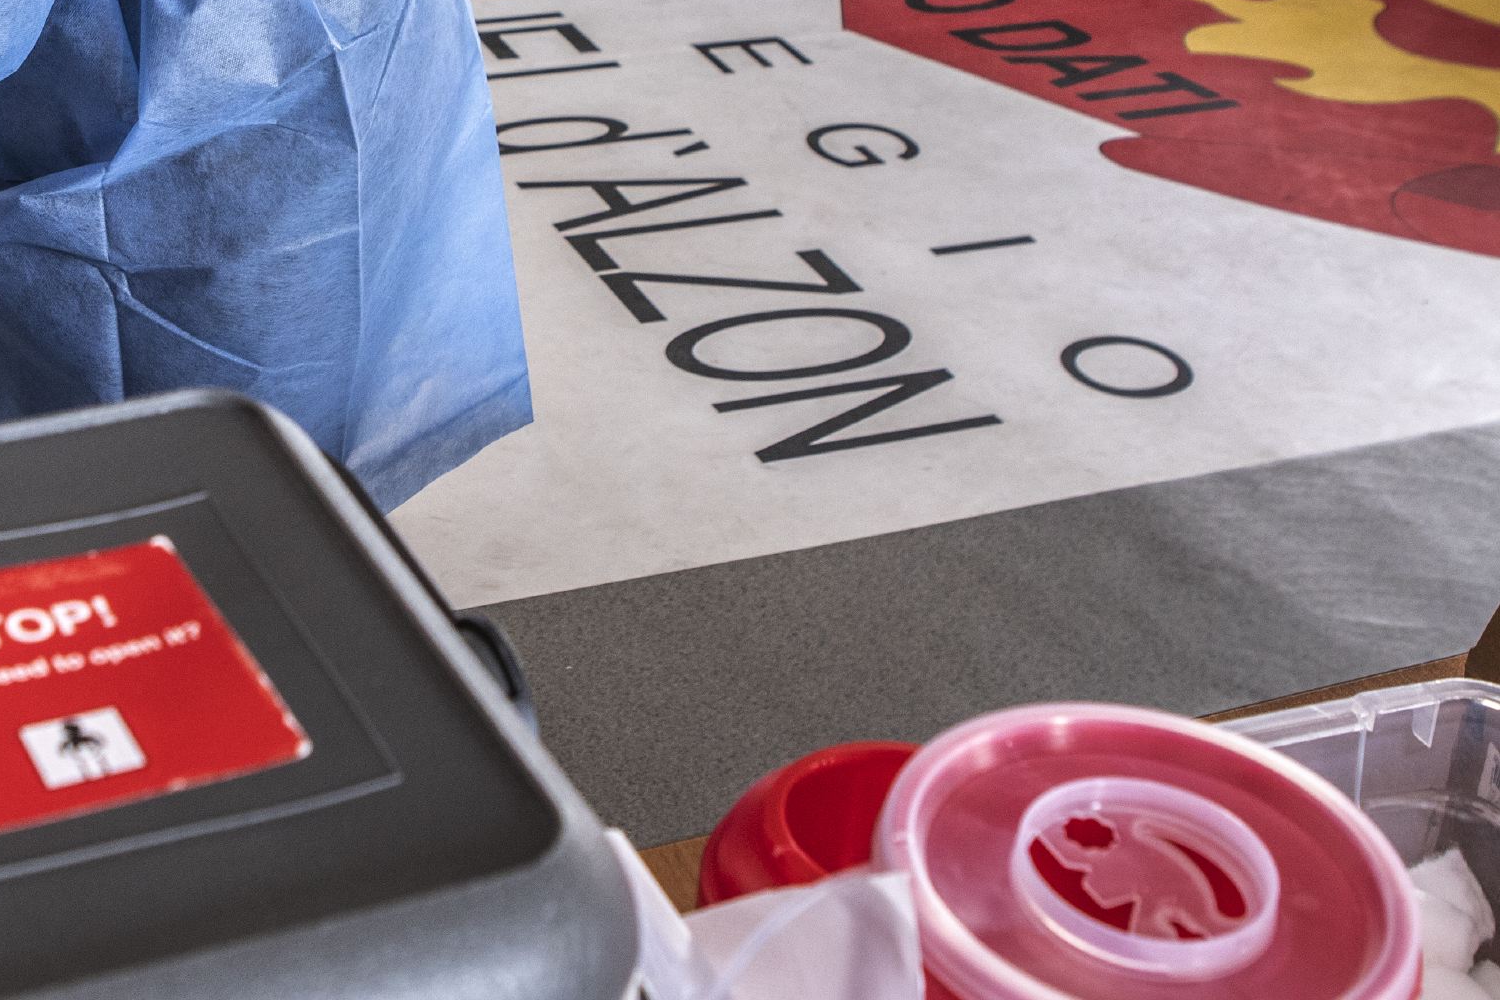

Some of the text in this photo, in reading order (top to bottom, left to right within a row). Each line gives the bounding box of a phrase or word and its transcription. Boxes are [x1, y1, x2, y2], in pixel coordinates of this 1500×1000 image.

[949, 20, 1241, 120] DATI
[52, 653, 86, 674] to
[88, 634, 163, 666] open
[162, 620, 202, 647] it?
